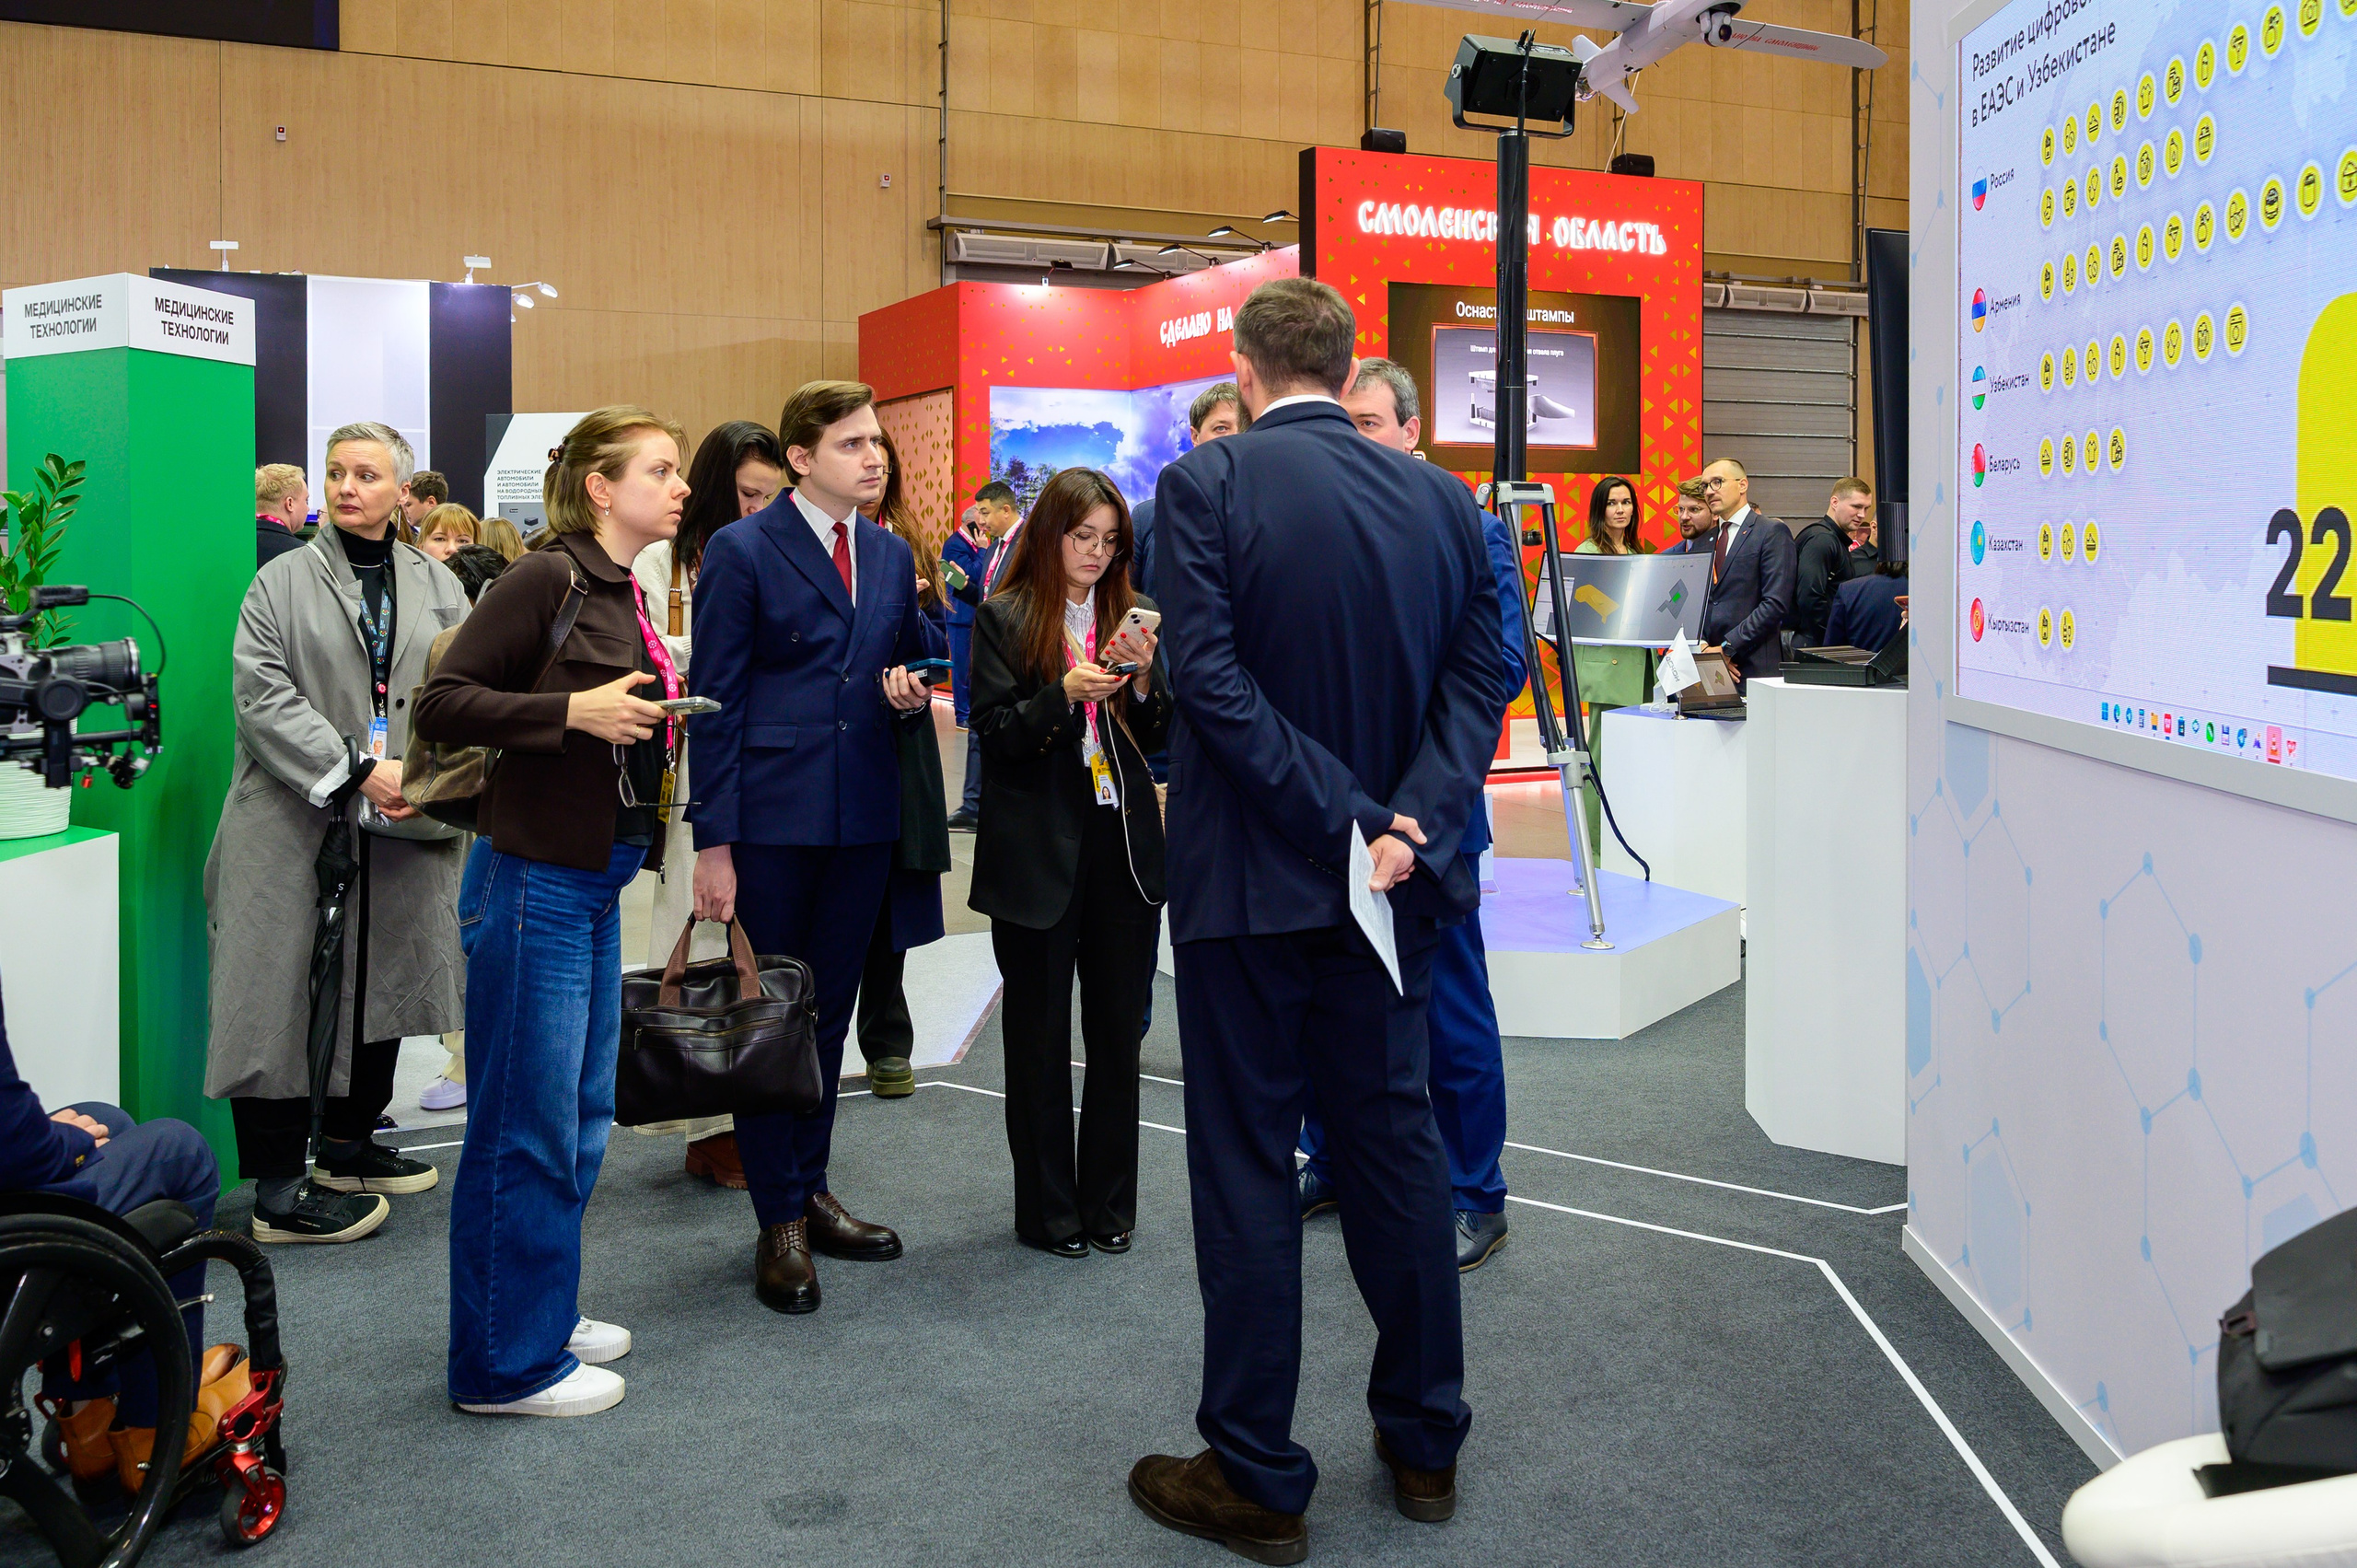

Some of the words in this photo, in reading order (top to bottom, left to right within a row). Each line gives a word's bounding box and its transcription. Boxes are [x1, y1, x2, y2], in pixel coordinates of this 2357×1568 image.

[1972, 29, 2025, 82] Развитие
[2027, 0, 2093, 45] цифров
[1972, 108, 1978, 128] в
[1980, 75, 2014, 122] ЕАЭС
[2016, 77, 2025, 100] и
[2027, 21, 2116, 93] Узбекистане
[1991, 168, 2014, 191] Россия
[1357, 200, 1540, 246] СМОЛЕНСКЯ
[1552, 215, 1667, 255] ОБЛАСТЬ
[24, 294, 103, 319] МЕДИЦИНСКИЕ
[154, 296, 235, 326] МЕДИЦИНСКИЕ
[1456, 301, 1497, 319] Оснаст
[1527, 308, 1574, 323] штампы
[1990, 293, 2021, 318] Армения
[29, 318, 98, 339] ТЕХНОЛОГИИ
[160, 320, 230, 346] ТЕХНОЛОГИИ
[1159, 310, 1213, 349] СДЕЛАНО
[1216, 306, 1234, 333] НА
[1990, 373, 2030, 393] Узбекистан
[1989, 455, 2021, 474] Беларусь
[1988, 534, 2024, 552] Казахстан
[2266, 506, 2352, 621] 22
[1988, 612, 2030, 635] Кыргызстан
